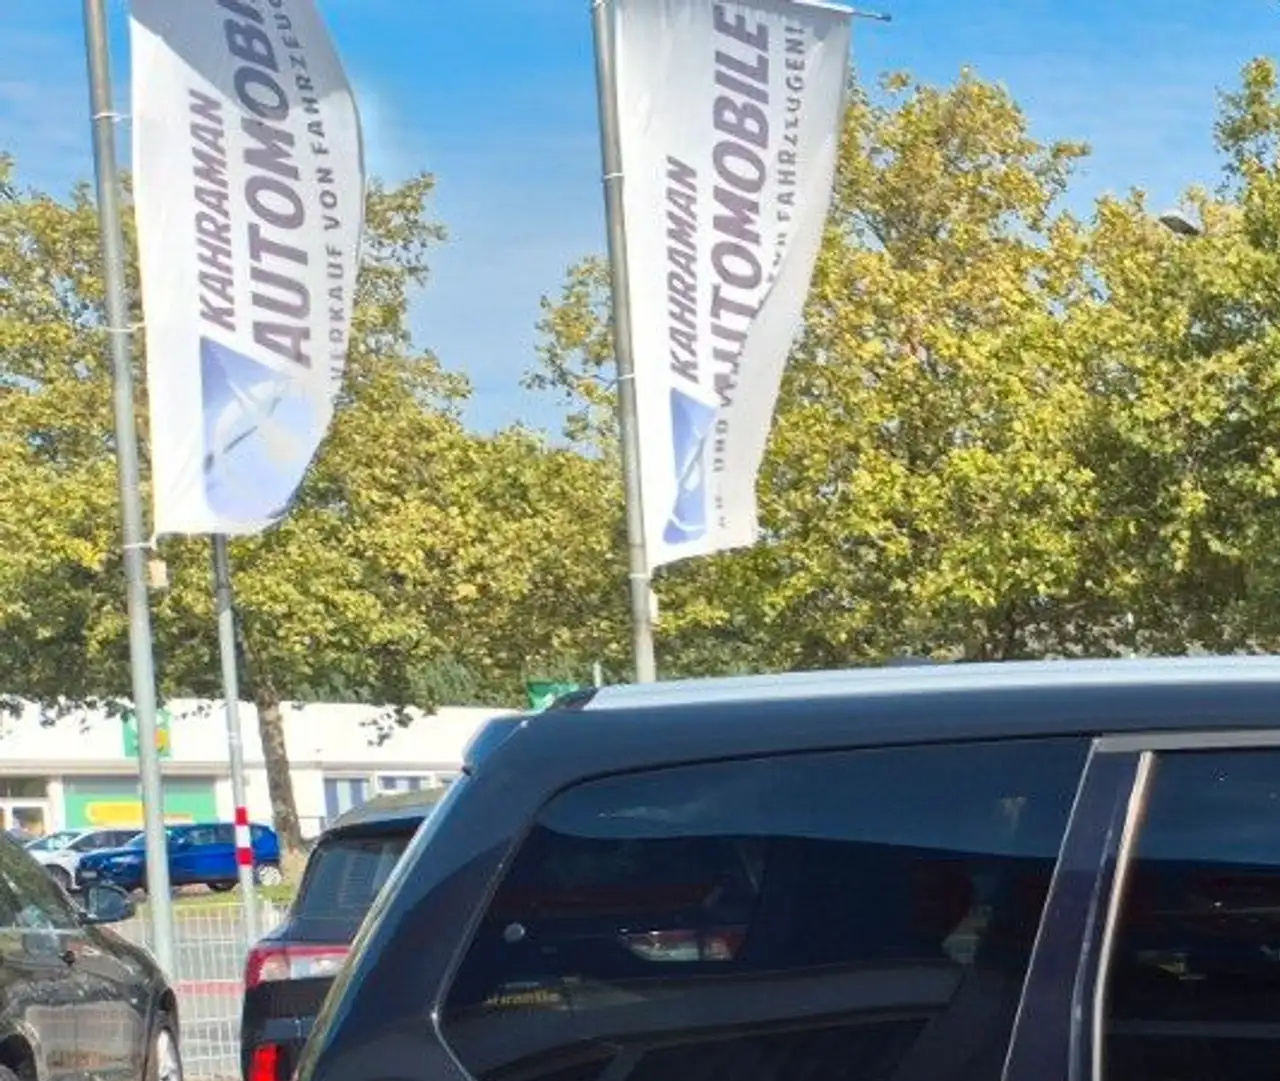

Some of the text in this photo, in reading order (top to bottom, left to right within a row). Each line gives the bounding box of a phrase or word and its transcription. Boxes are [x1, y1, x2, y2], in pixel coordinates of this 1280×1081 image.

[188, 88, 237, 332] KAHRAMAN
[316, 167, 341, 231] VON
[665, 155, 699, 384] KAHRAMAN
